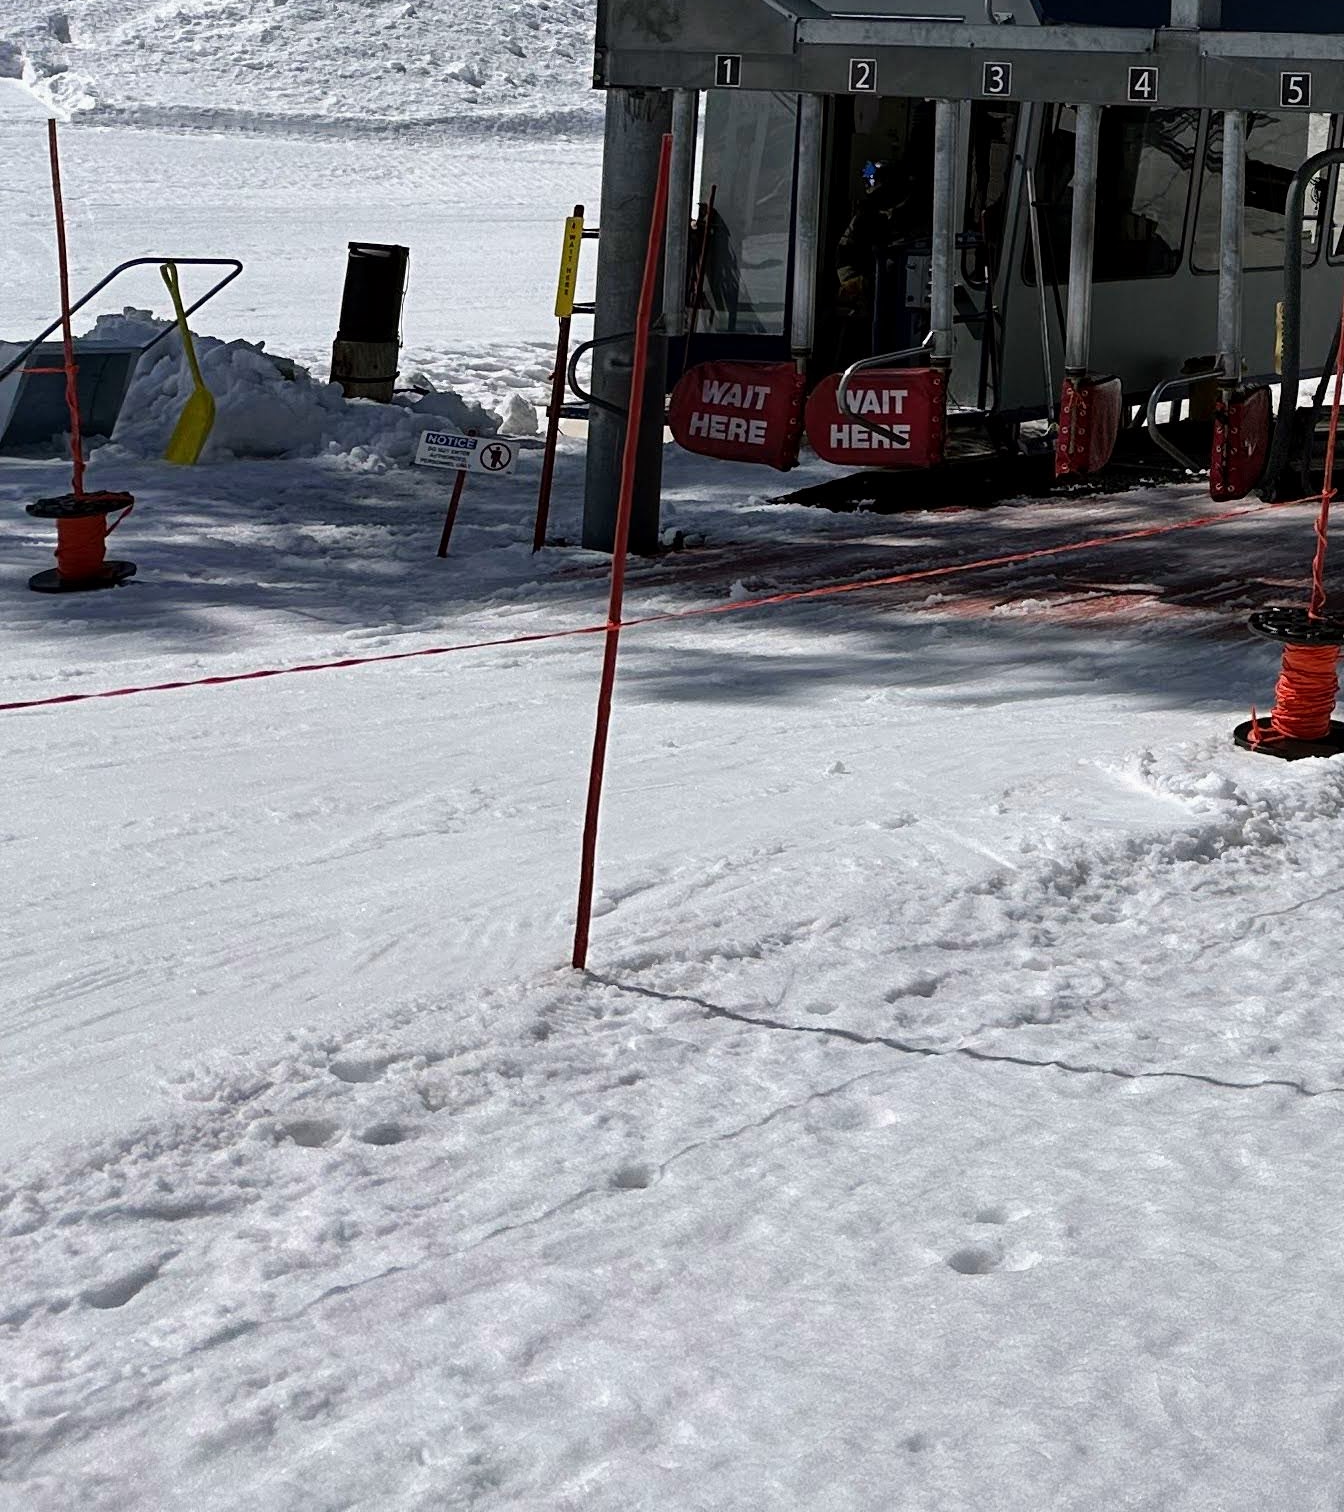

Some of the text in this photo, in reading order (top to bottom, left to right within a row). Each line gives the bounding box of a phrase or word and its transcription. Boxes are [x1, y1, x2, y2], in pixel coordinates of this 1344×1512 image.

[722, 58, 732, 84] 1
[855, 63, 871, 89] 2
[989, 66, 1004, 93] 3
[1134, 71, 1152, 98] 4
[1288, 76, 1303, 104] 5
[702, 380, 771, 410] WAIT
[836, 390, 908, 414] WAIT
[428, 433, 476, 449] NOTICE
[688, 412, 768, 445] HERE
